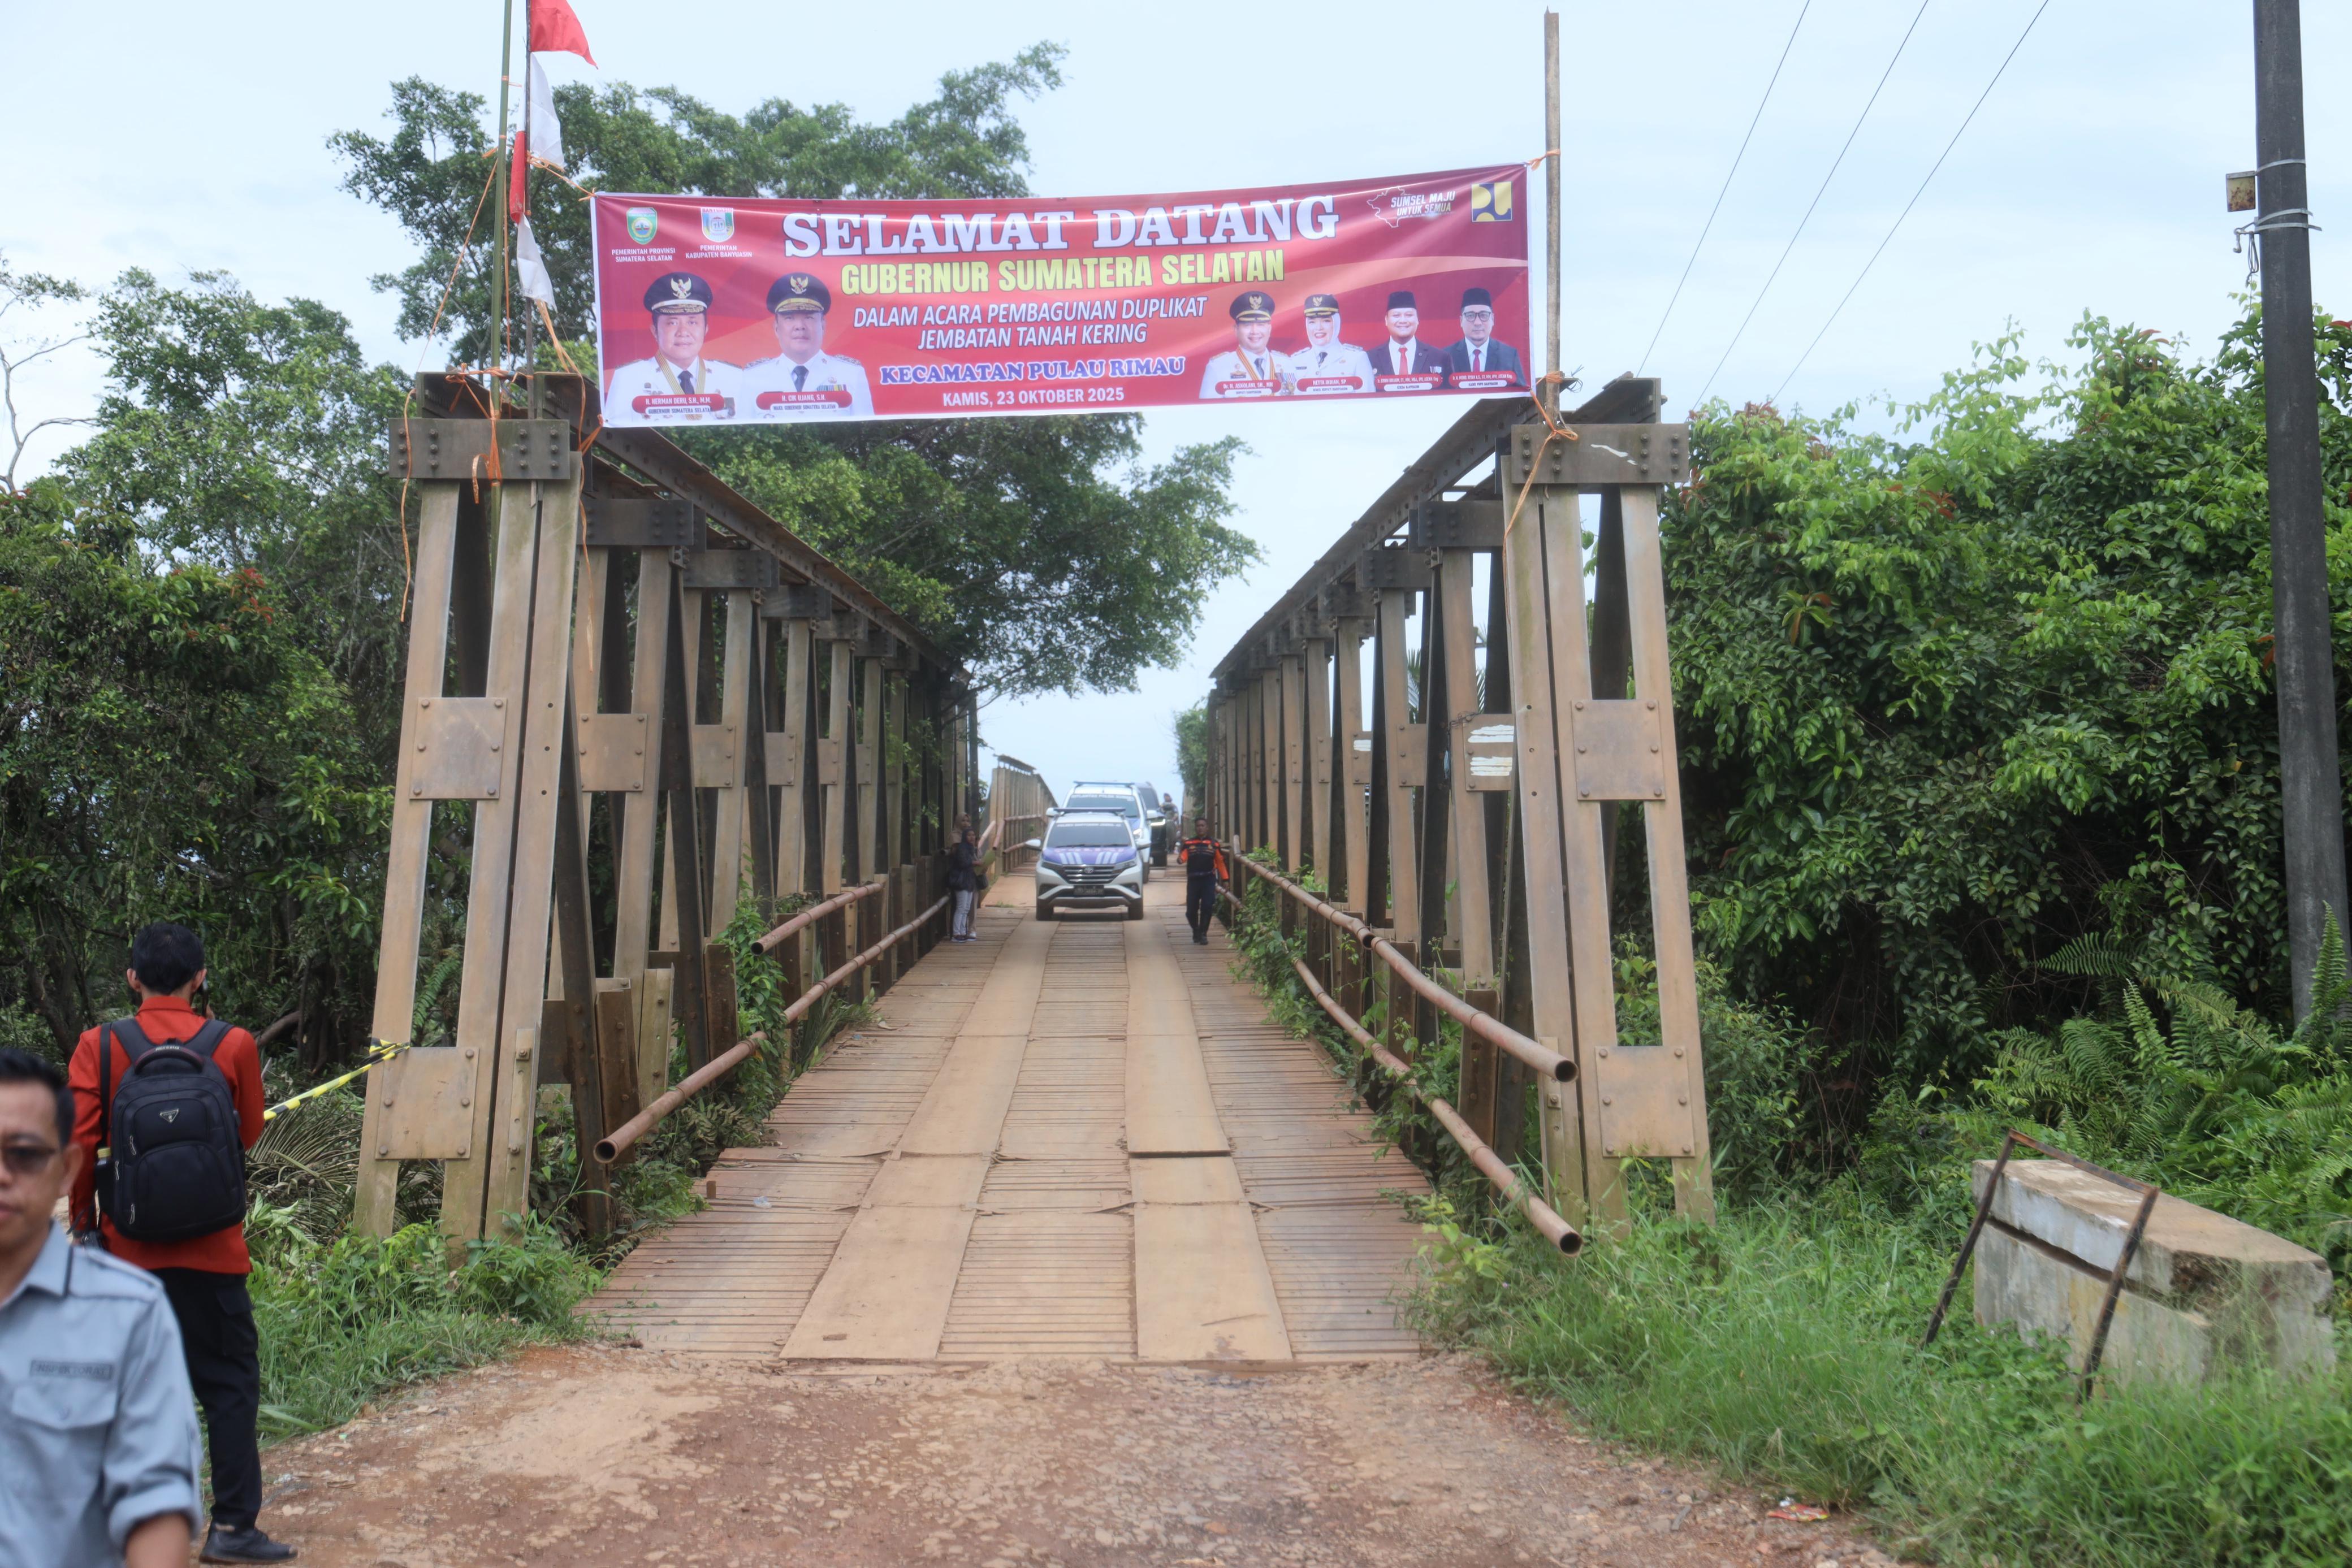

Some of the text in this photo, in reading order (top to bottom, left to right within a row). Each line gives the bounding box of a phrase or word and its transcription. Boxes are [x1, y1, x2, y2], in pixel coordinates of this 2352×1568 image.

[1391, 191, 1456, 208] SUMSEL MAJU
[1397, 202, 1451, 216] UNTUK SEMUA
[782, 196, 1339, 258] SELAMAT DATANG
[841, 249, 1285, 295] GUBERNUR SUMATERA SELATAN
[853, 296, 1208, 328] DALAM ACARA PEMBAGUNAN DUPLIKAT
[918, 323, 1147, 350] JEMBATAN TANAH KERING
[880, 356, 1186, 385] KECAMATAN PULAU RIMAU
[943, 387, 1125, 408] KAMIS, 23 OKTOBER 2025
